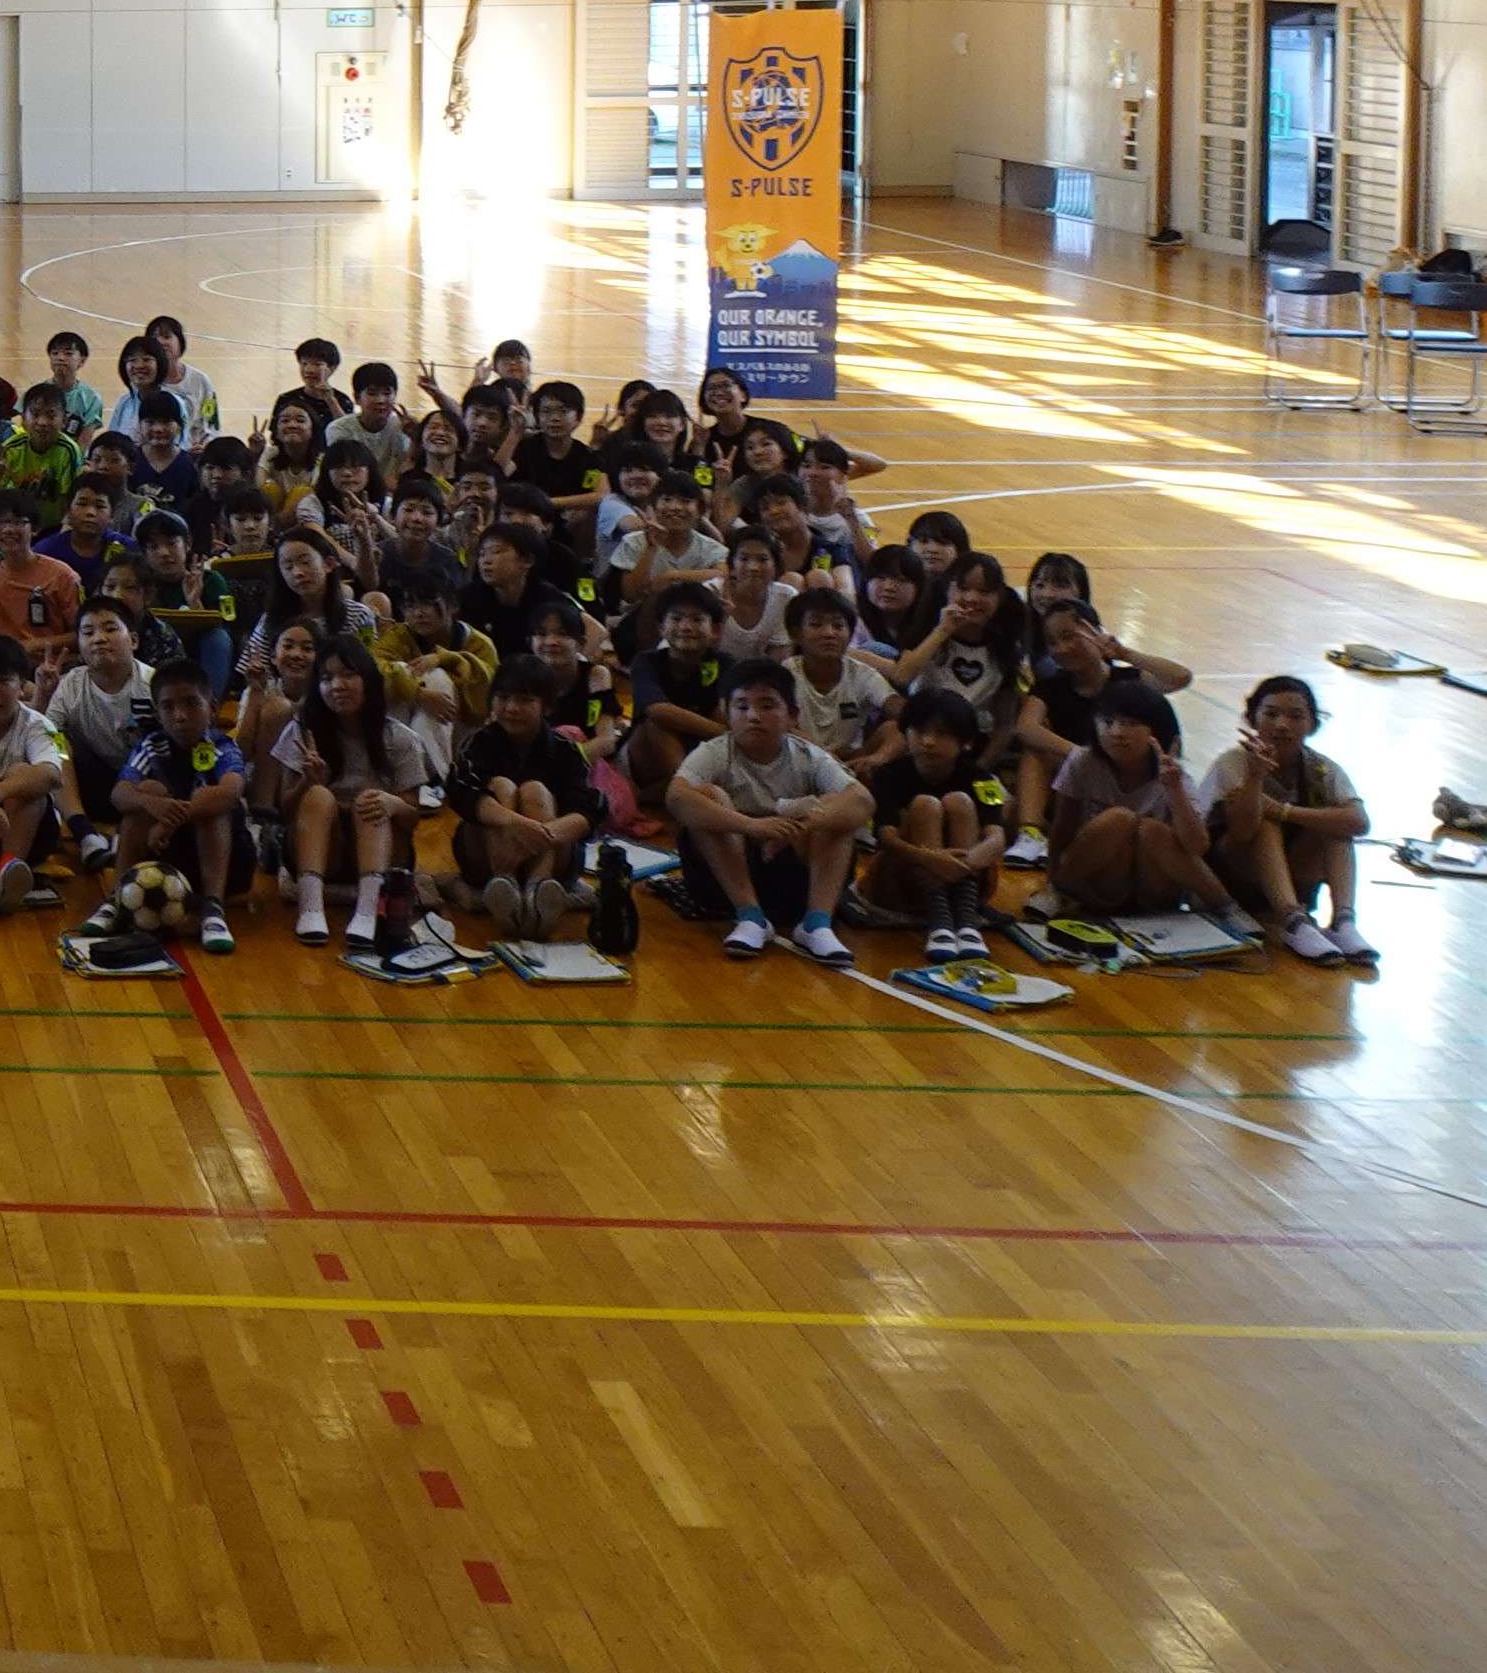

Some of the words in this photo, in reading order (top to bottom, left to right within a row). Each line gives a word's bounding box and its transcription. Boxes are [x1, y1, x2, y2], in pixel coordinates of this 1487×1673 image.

[730, 87, 811, 108] S-PULSE
[730, 176, 814, 198] S-PULSE
[717, 309, 751, 326] OUR
[717, 329, 751, 346] OUR
[754, 329, 819, 347] SYMBOL
